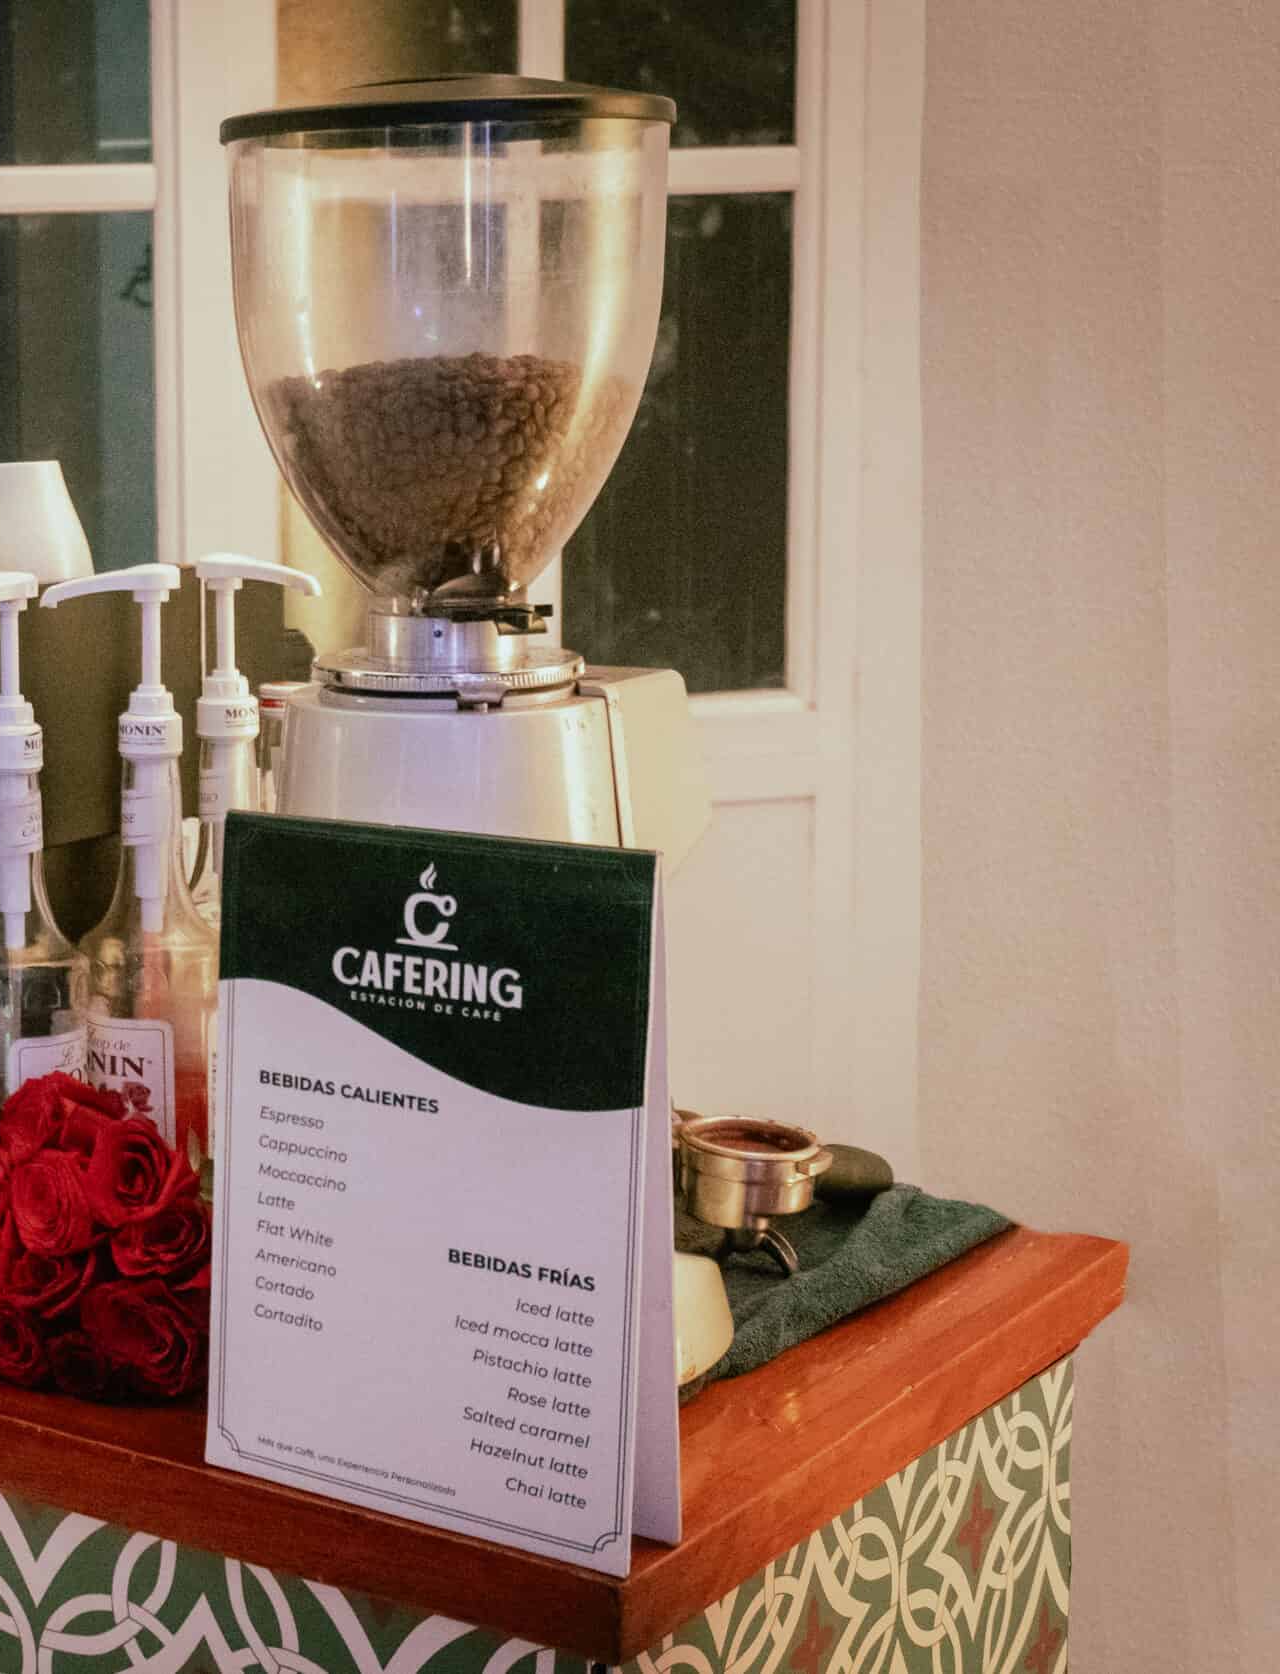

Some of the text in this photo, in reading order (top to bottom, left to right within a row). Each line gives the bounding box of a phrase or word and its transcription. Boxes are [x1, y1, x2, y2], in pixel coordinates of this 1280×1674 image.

[332, 946, 523, 1009] CAFERING
[433, 1003, 453, 1015] DE
[259, 1069, 439, 1114] BEBIDAS CALIENTES
[259, 1105, 325, 1130] Espresso
[258, 1135, 348, 1164] Cappuccino
[258, 1163, 347, 1192] Moccaccino
[257, 1192, 296, 1211] Latte
[256, 1219, 334, 1248] Flat White
[255, 1248, 337, 1278] Americano
[448, 1248, 596, 1292] BEBIDAS FRÍAS
[255, 1276, 315, 1302] Cortado
[254, 1304, 323, 1332] Cortadito
[515, 1298, 595, 1328] Iced latte
[455, 1315, 593, 1358] Iced mocca latte
[472, 1348, 593, 1389] Pistachio latte
[507, 1387, 592, 1419] Rose latte
[463, 1406, 591, 1449] Salted caramel
[470, 1437, 589, 1479] Hazelnut latte
[504, 1476, 587, 1510] Chai latte
